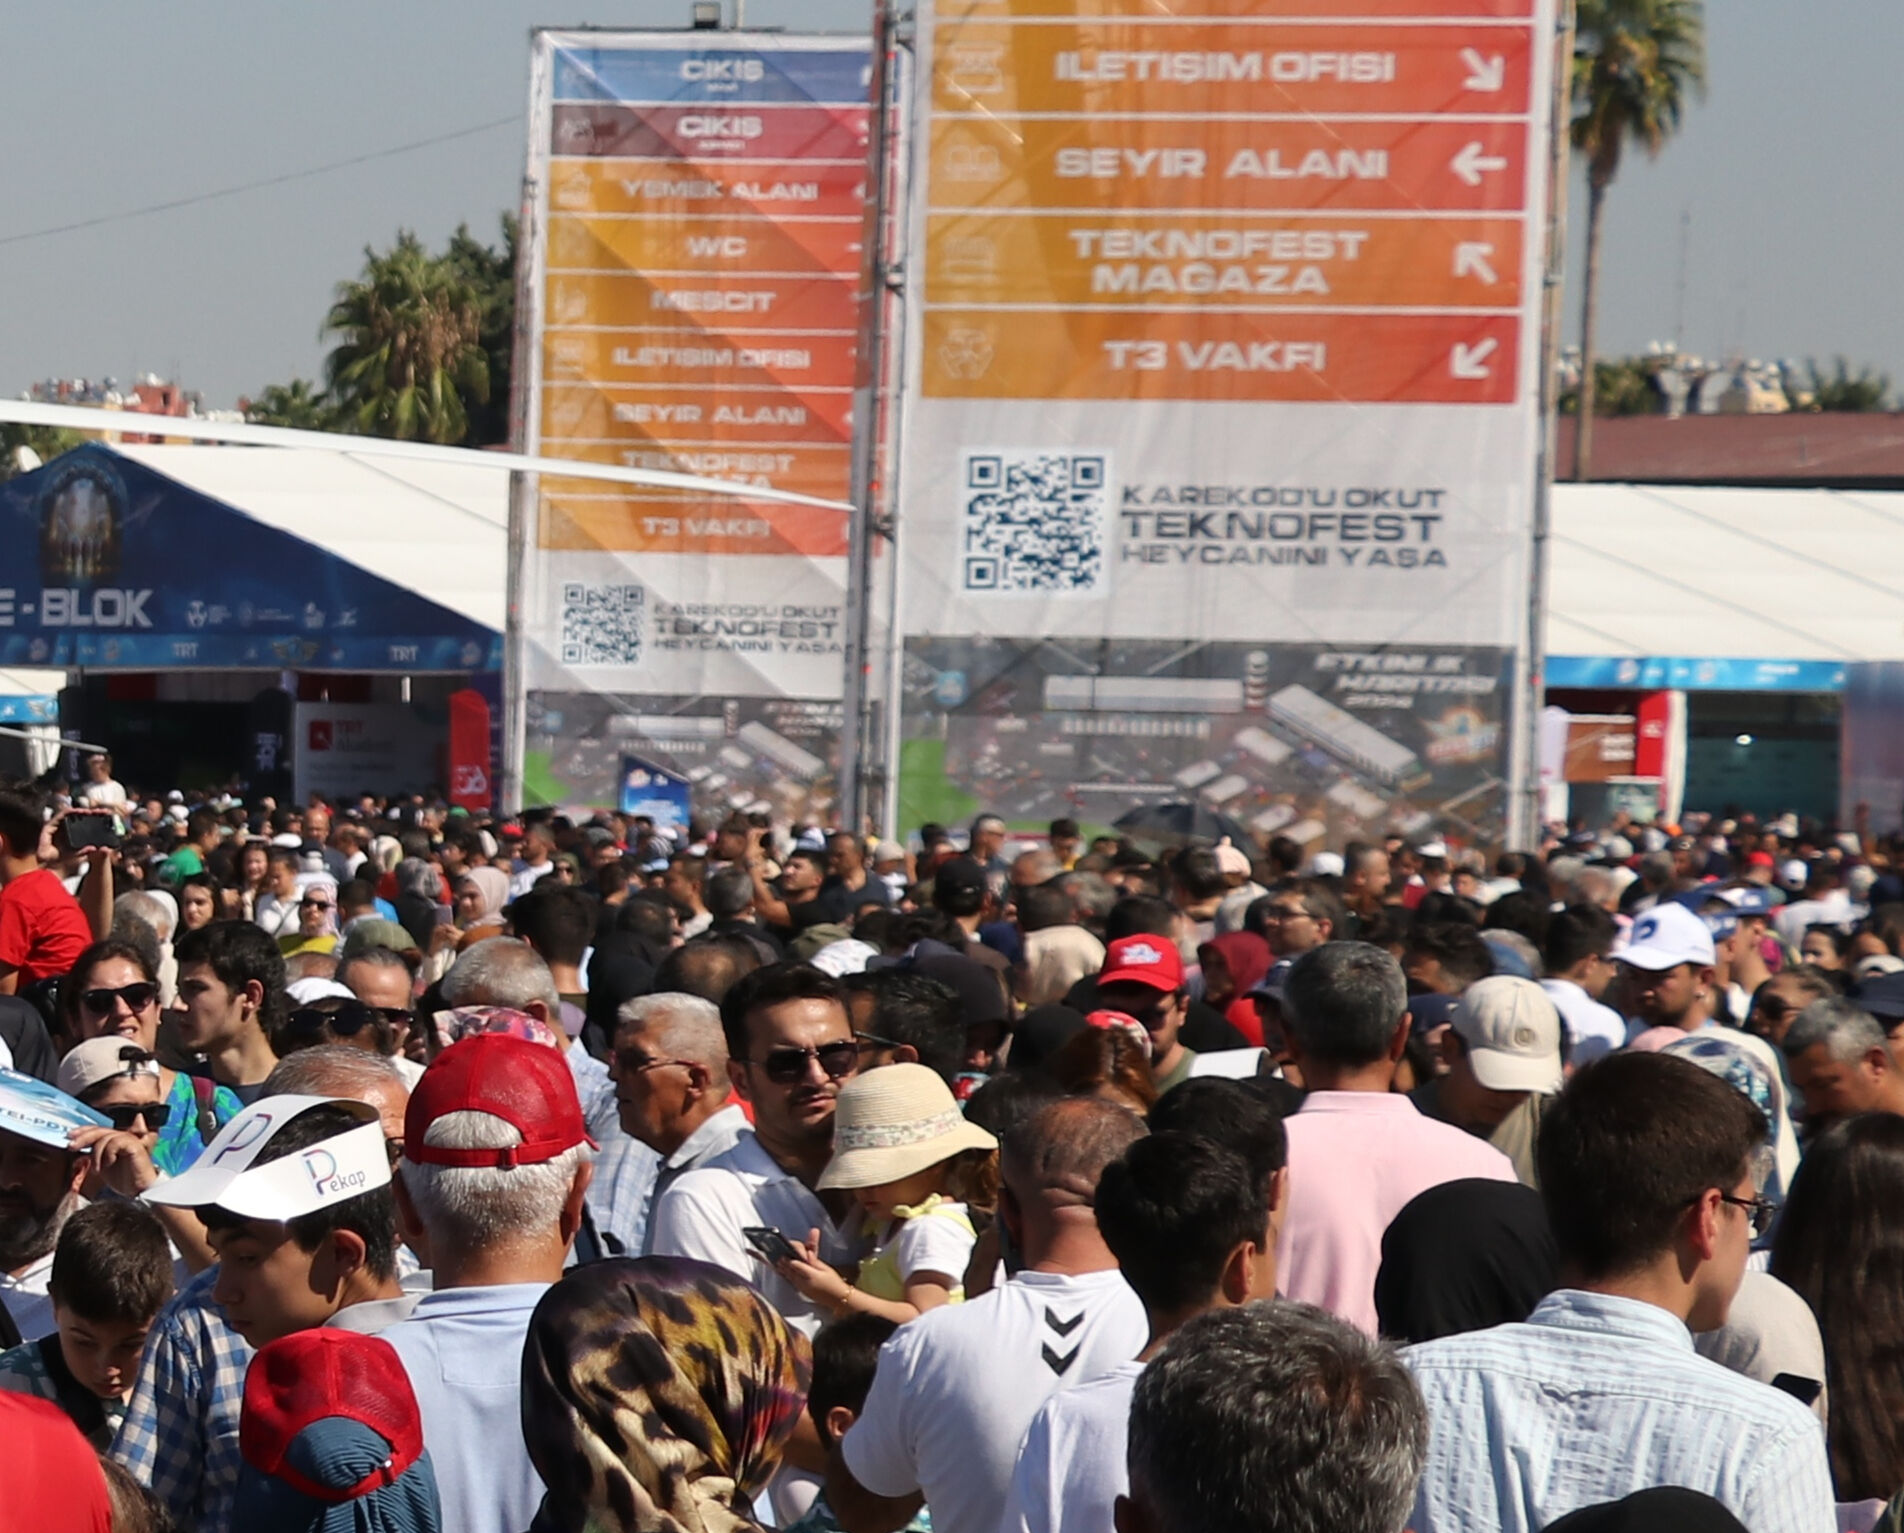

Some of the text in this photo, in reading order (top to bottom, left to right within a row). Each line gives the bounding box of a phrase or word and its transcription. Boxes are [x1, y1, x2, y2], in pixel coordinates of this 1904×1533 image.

[1223, 149, 1388, 180] ALANI
[686, 237, 747, 258] WC
[1068, 228, 1369, 261] TEKNOFEST
[1102, 340, 1327, 372] T3 VAKFI
[1344, 488, 1447, 509] OKUT
[643, 517, 680, 536] T3
[1120, 510, 1442, 542] TEKNOFEST
[653, 618, 839, 638] TEKNOFEST
